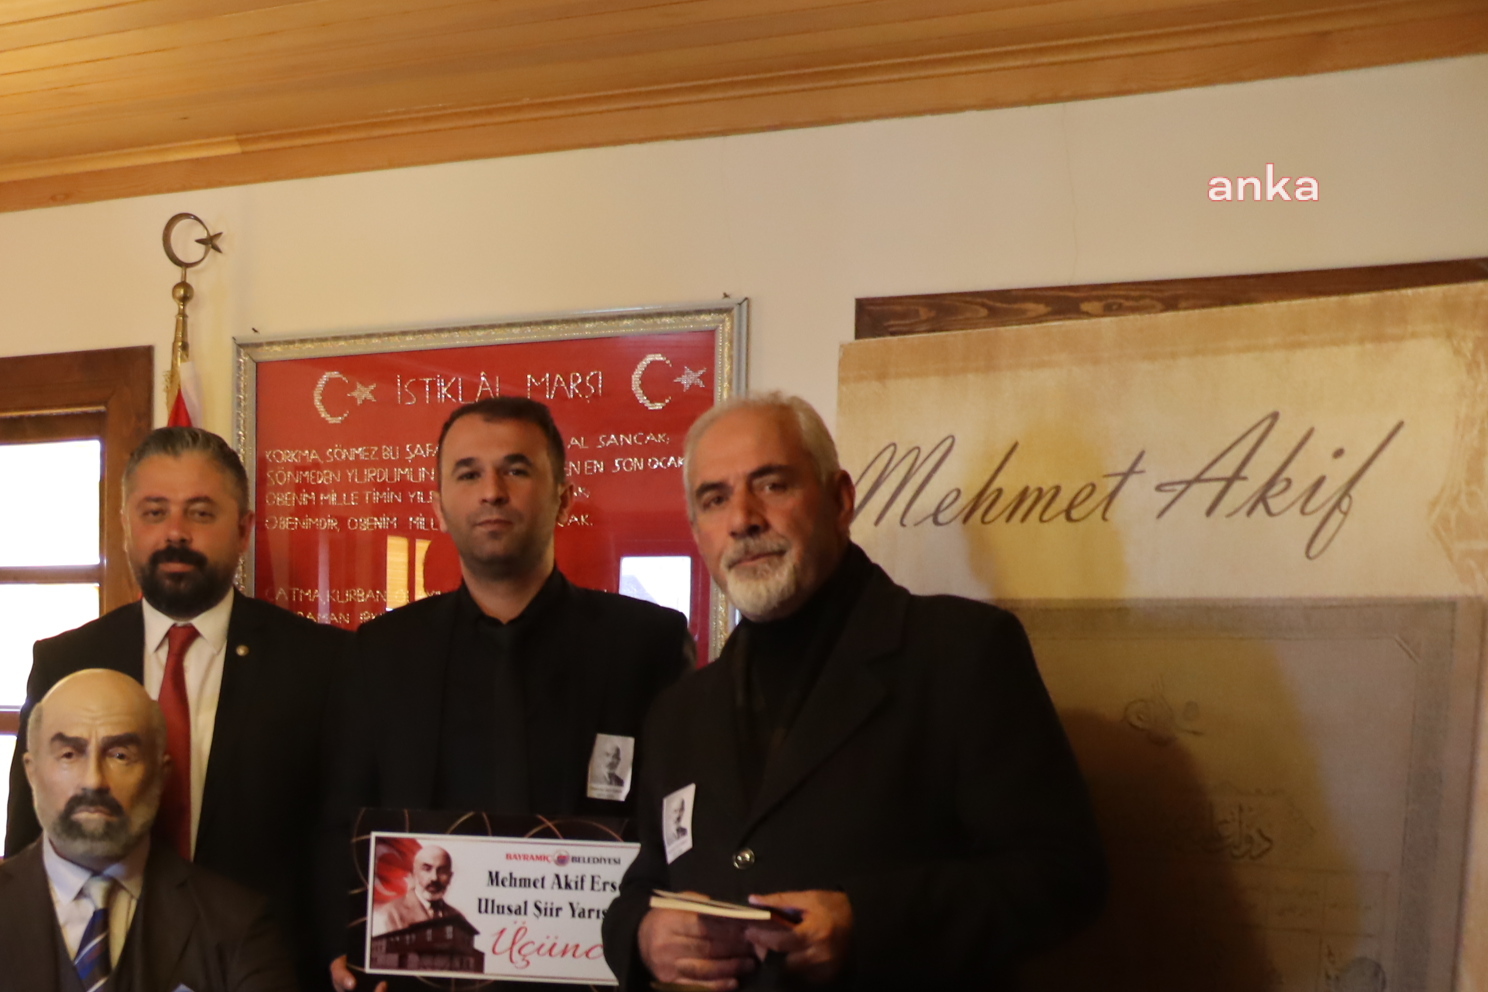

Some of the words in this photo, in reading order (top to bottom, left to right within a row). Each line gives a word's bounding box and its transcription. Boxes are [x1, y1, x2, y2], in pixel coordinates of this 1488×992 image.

[852, 434, 1146, 528] Mehmet
[1154, 410, 1405, 560] Akif
[487, 870, 546, 889] Mehmet
[550, 872, 586, 891] Akif
[590, 874, 620, 893] Ers
[477, 897, 529, 917] Ulusal
[532, 899, 563, 920] Şiir
[491, 920, 605, 970] Üçünc
